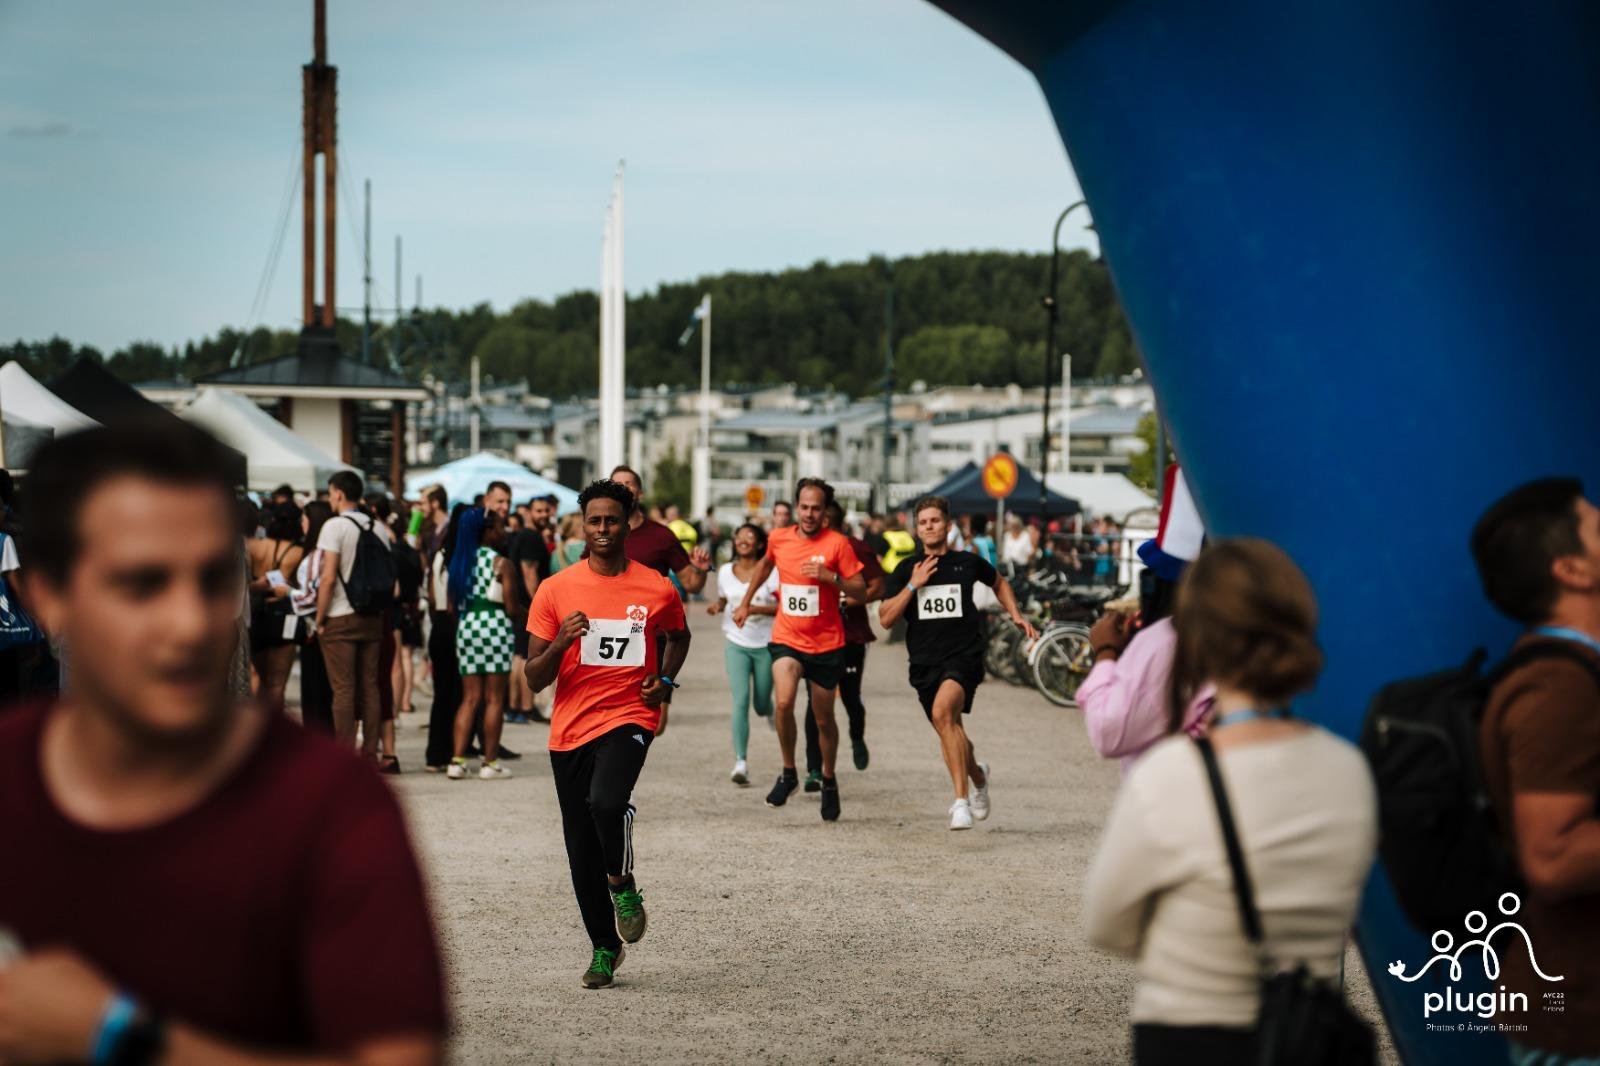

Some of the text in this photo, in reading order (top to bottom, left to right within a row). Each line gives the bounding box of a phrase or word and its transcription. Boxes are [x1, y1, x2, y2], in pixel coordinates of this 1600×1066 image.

[788, 596, 808, 612] 86
[923, 597, 957, 614] 480
[599, 636, 630, 660] 57
